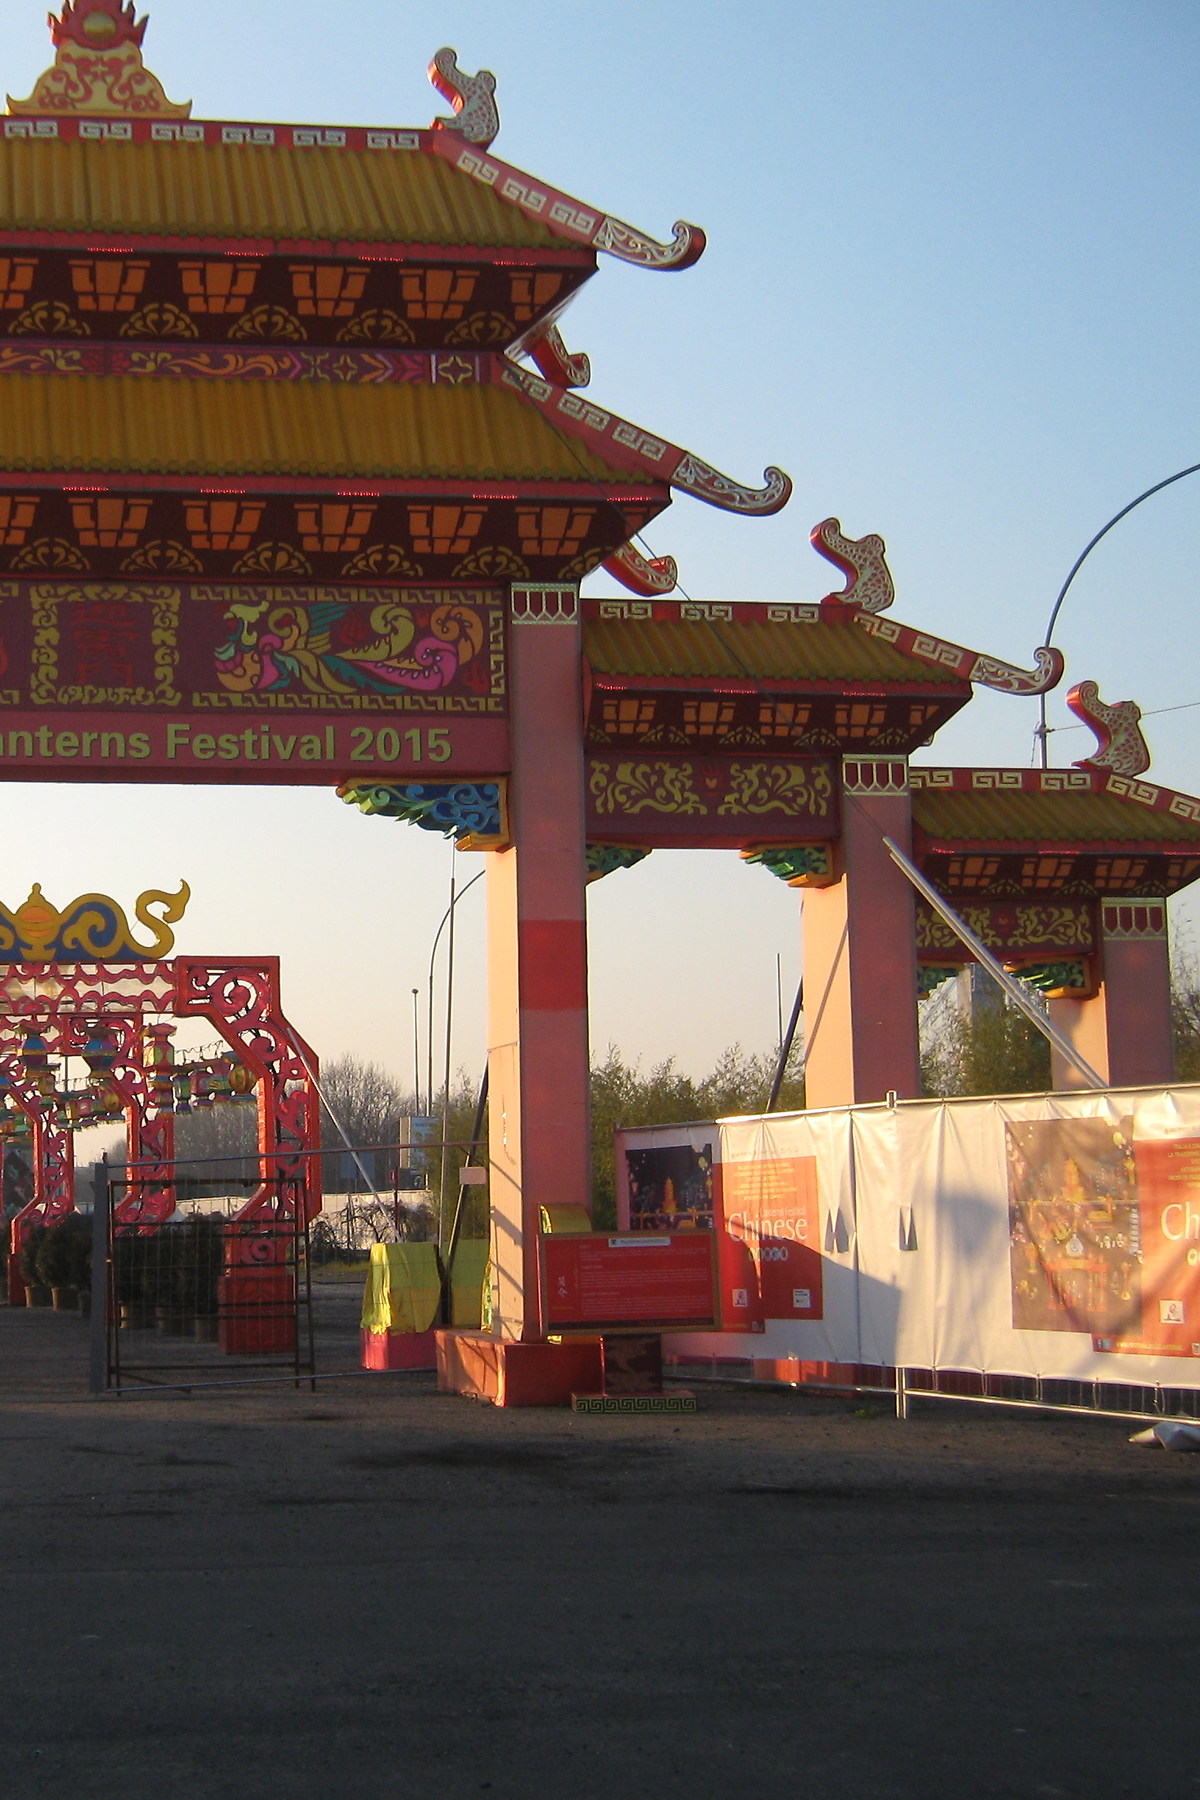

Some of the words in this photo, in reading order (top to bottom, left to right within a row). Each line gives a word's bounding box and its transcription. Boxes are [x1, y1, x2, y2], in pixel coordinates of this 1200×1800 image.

[166, 723, 335, 760] Festival
[350, 726, 452, 763] 2015
[727, 1211, 808, 1242] Chinese
